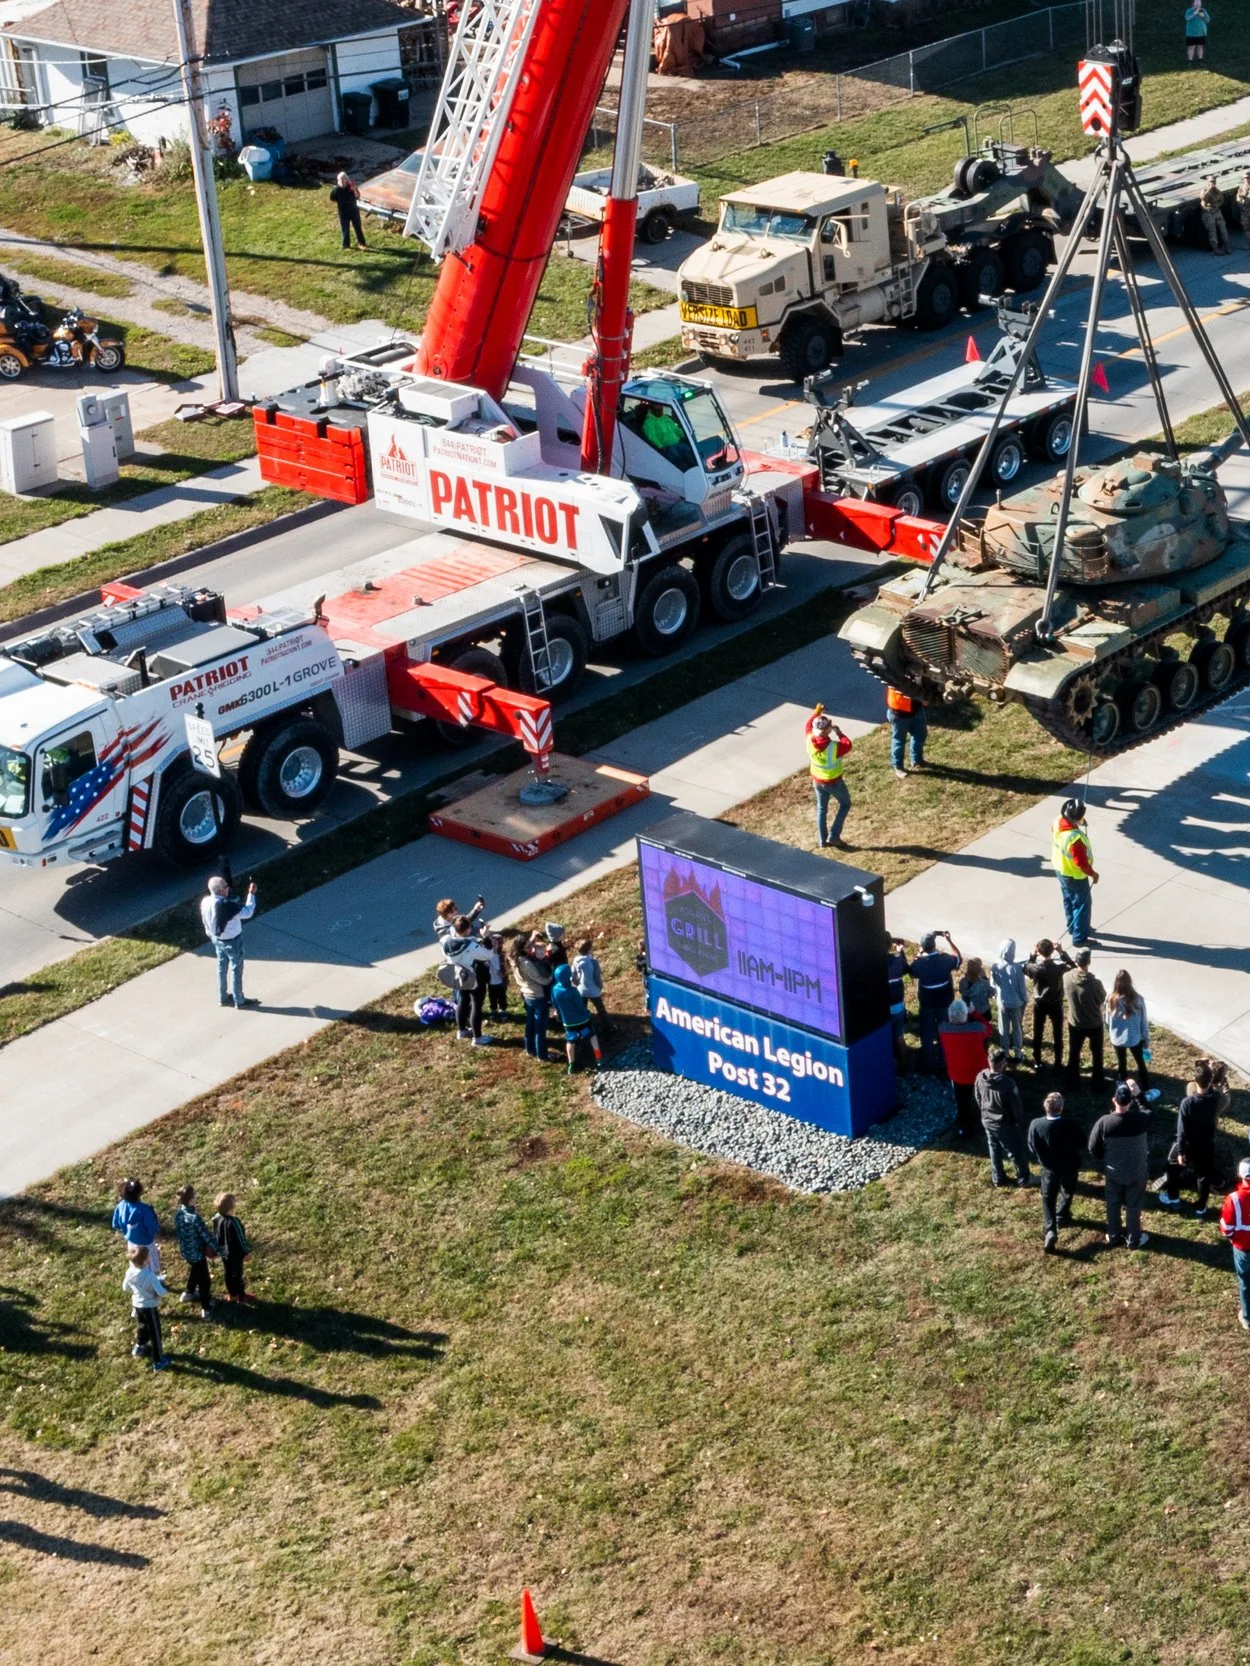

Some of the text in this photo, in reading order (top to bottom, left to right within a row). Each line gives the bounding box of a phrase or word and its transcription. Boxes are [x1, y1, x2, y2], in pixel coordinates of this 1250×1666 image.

[722, 308, 748, 327] LOAD
[381, 455, 416, 477] PATRIOT
[429, 469, 580, 549] PATRIOT
[169, 655, 249, 701] PATRIOT
[293, 656, 337, 683] GROVE
[193, 745, 215, 769] 25
[671, 917, 723, 951] GRILL
[656, 996, 844, 1088] American Legion
[708, 1050, 792, 1102] Post 32
